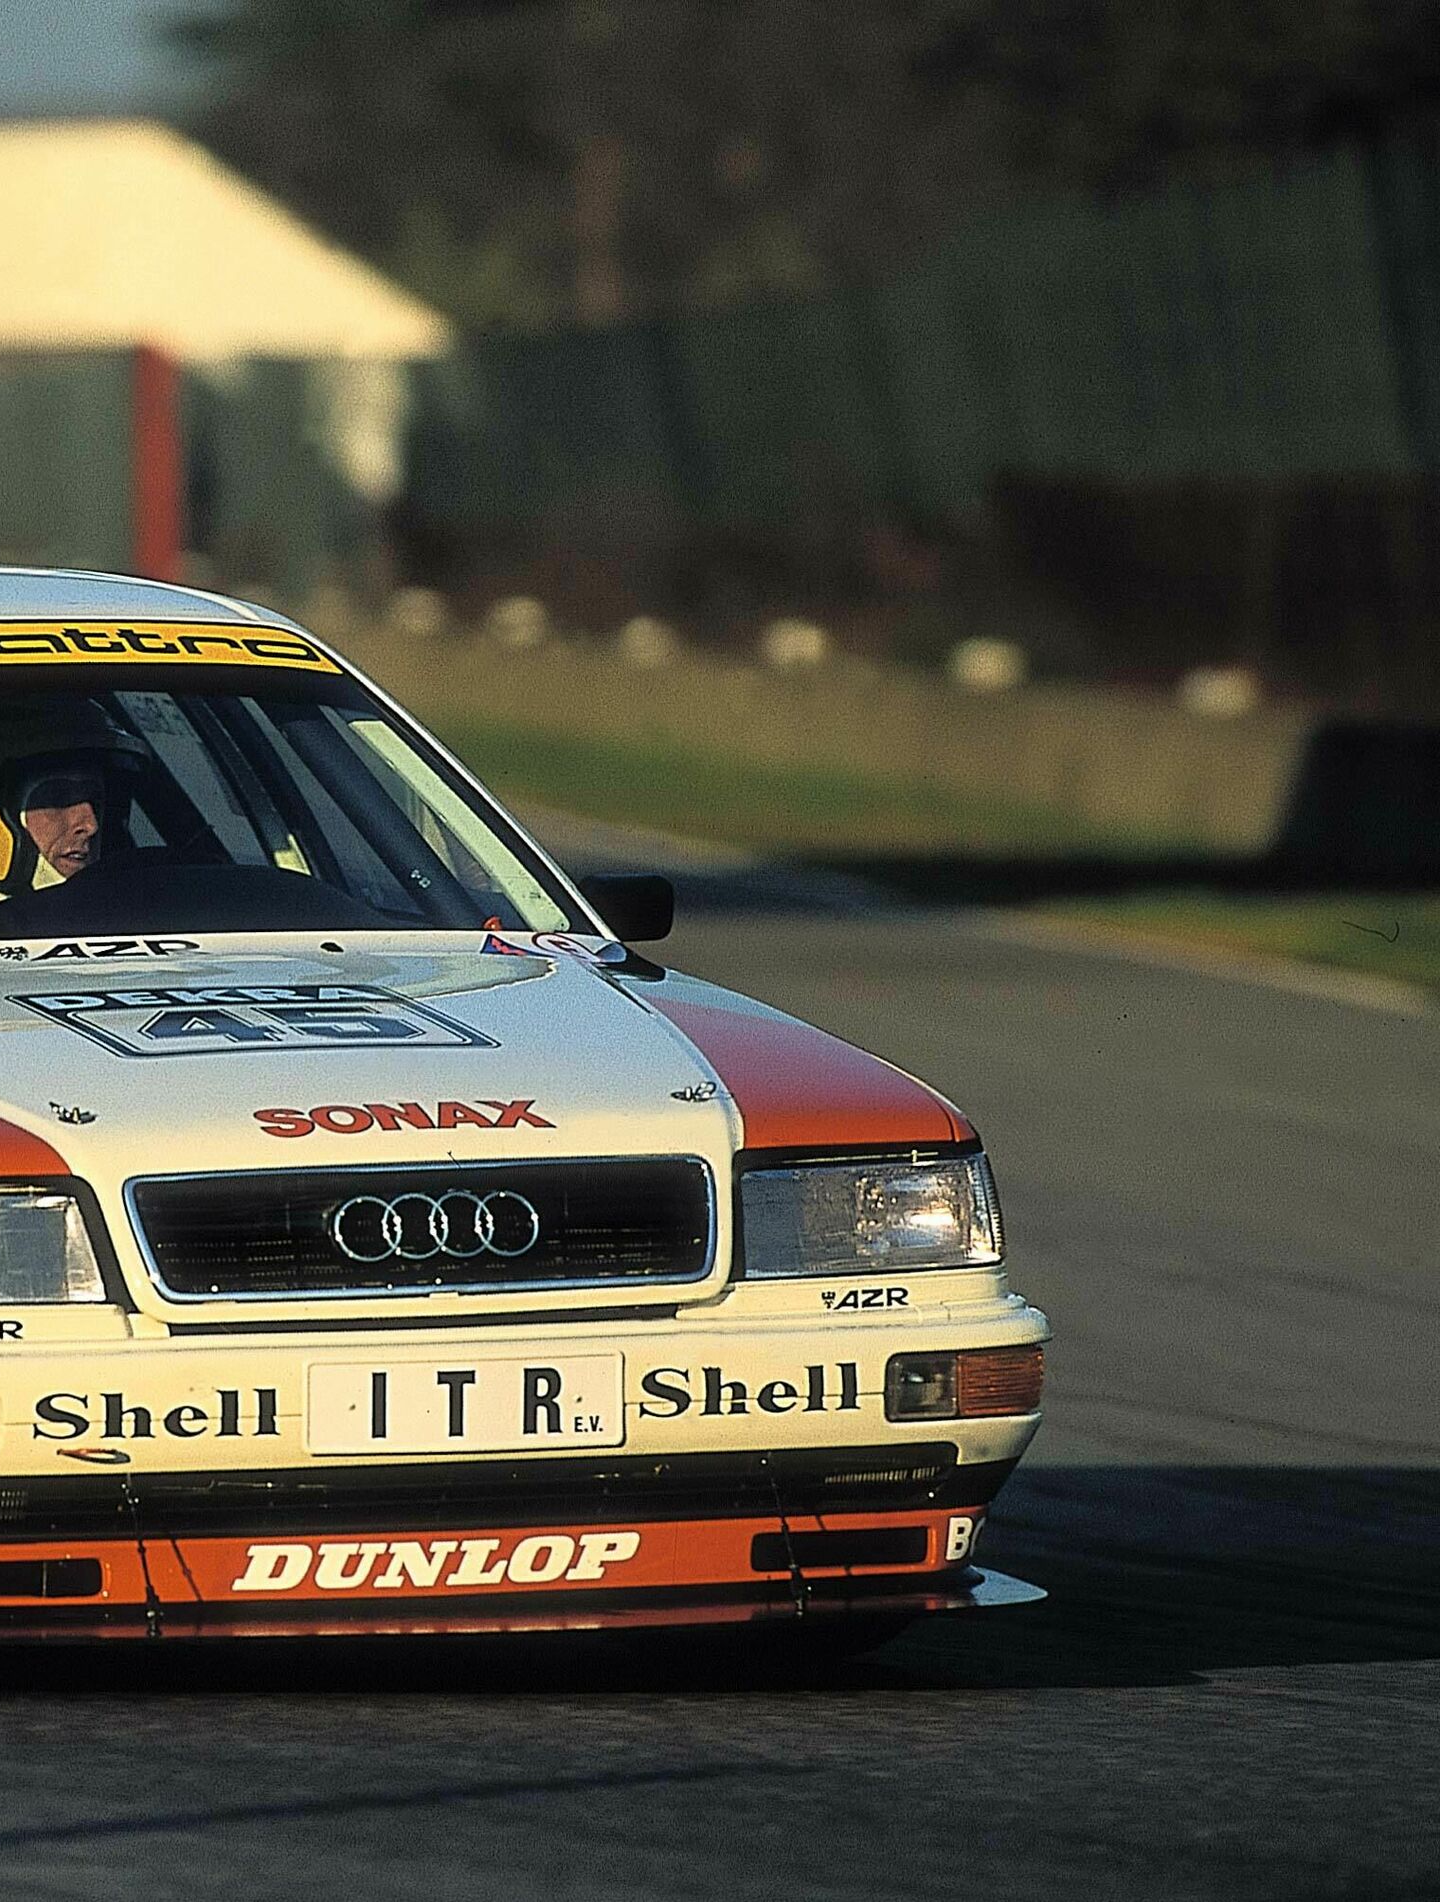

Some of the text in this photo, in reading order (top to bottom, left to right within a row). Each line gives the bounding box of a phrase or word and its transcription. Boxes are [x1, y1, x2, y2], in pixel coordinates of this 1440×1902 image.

[26, 986, 384, 1011] DEKRA
[136, 1006, 429, 1042] 45
[252, 1100, 558, 1139] SONAX
[834, 1287, 910, 1311] AZR
[639, 1362, 862, 1419] Shell
[33, 1388, 281, 1440] Shell
[574, 1415, 603, 1433] E.V.
[945, 1516, 986, 1561] B
[232, 1531, 641, 1592] DUNLOP
